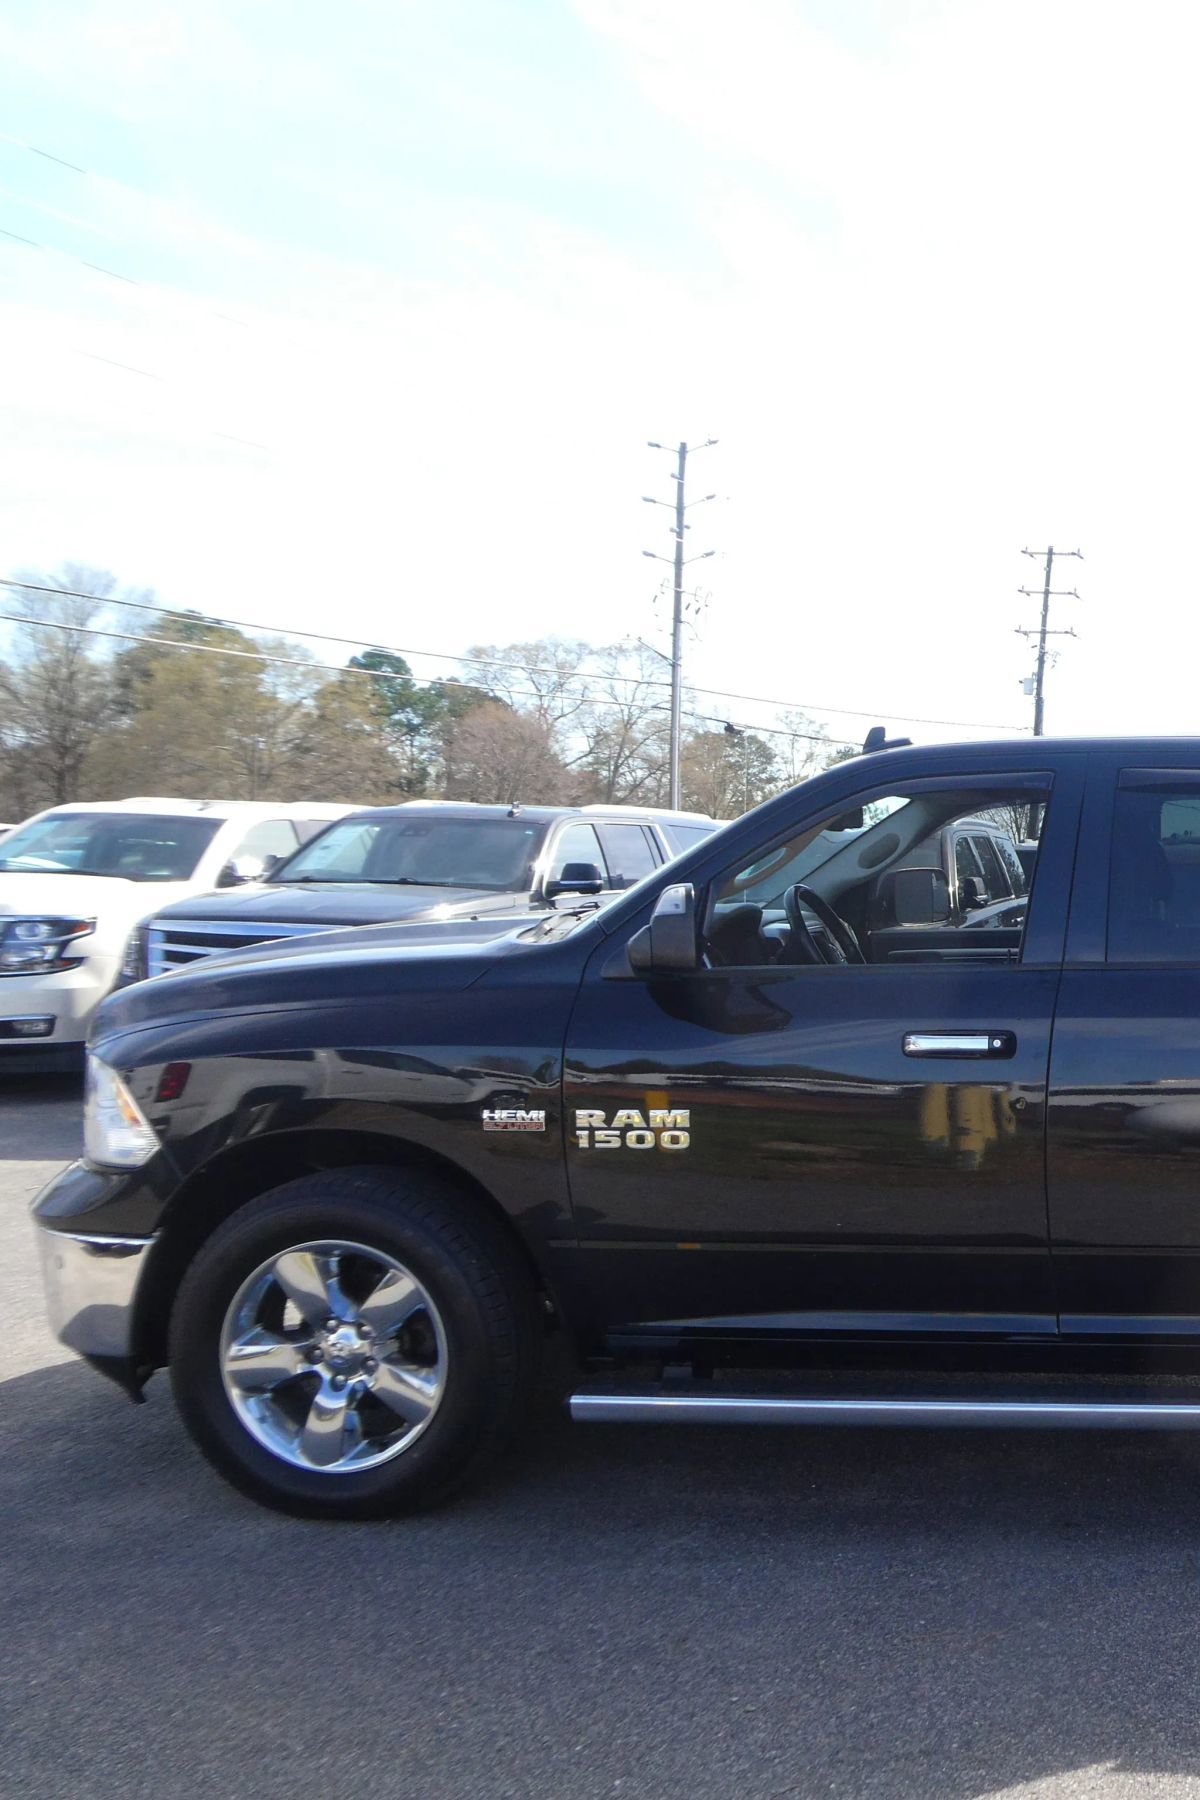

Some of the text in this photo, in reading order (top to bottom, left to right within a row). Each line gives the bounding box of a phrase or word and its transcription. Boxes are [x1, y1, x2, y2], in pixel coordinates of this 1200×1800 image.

[482, 1109, 546, 1120] HEMI
[575, 1109, 691, 1128] RAM
[575, 1130, 691, 1149] 1500
